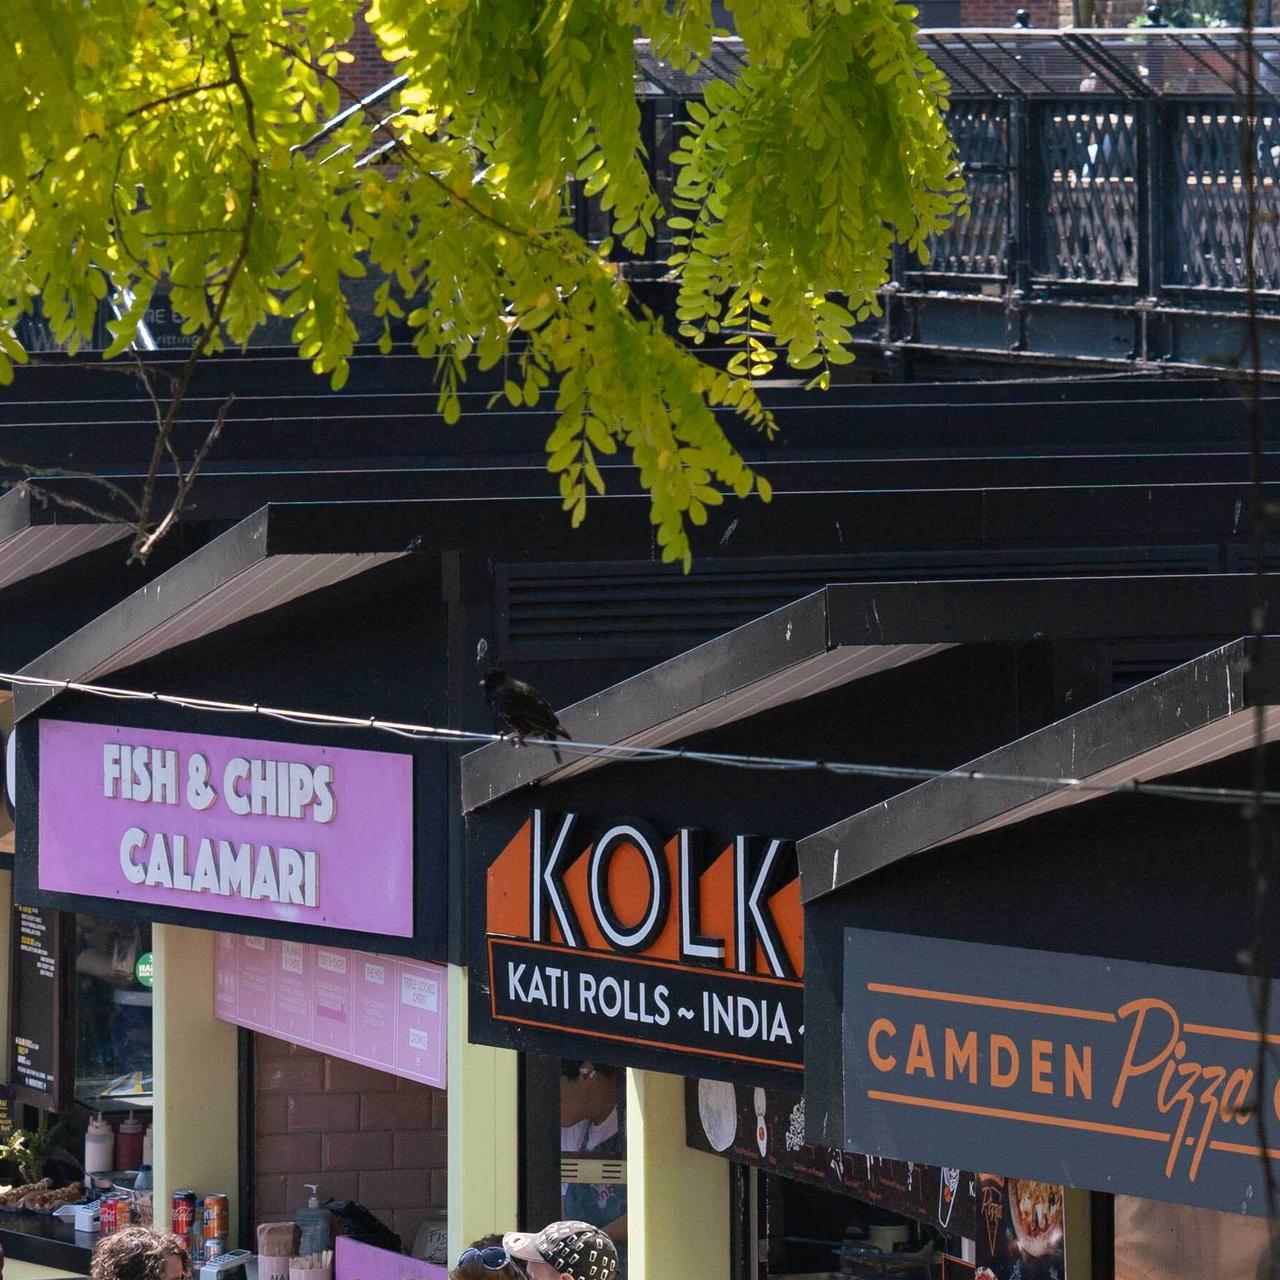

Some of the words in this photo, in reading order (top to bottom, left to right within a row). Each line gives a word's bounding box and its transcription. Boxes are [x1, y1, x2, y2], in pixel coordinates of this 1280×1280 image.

[102, 742, 178, 806] FISH
[186, 751, 217, 812] &
[221, 755, 338, 825] CHIPS
[118, 825, 321, 909] CALAMARI
[506, 959, 570, 1011] KATI
[578, 971, 671, 1027] ROLLS
[701, 990, 788, 1041] INDIA
[866, 1016, 1094, 1101] CAMDEN
[1111, 997, 1255, 1182] Pizza
